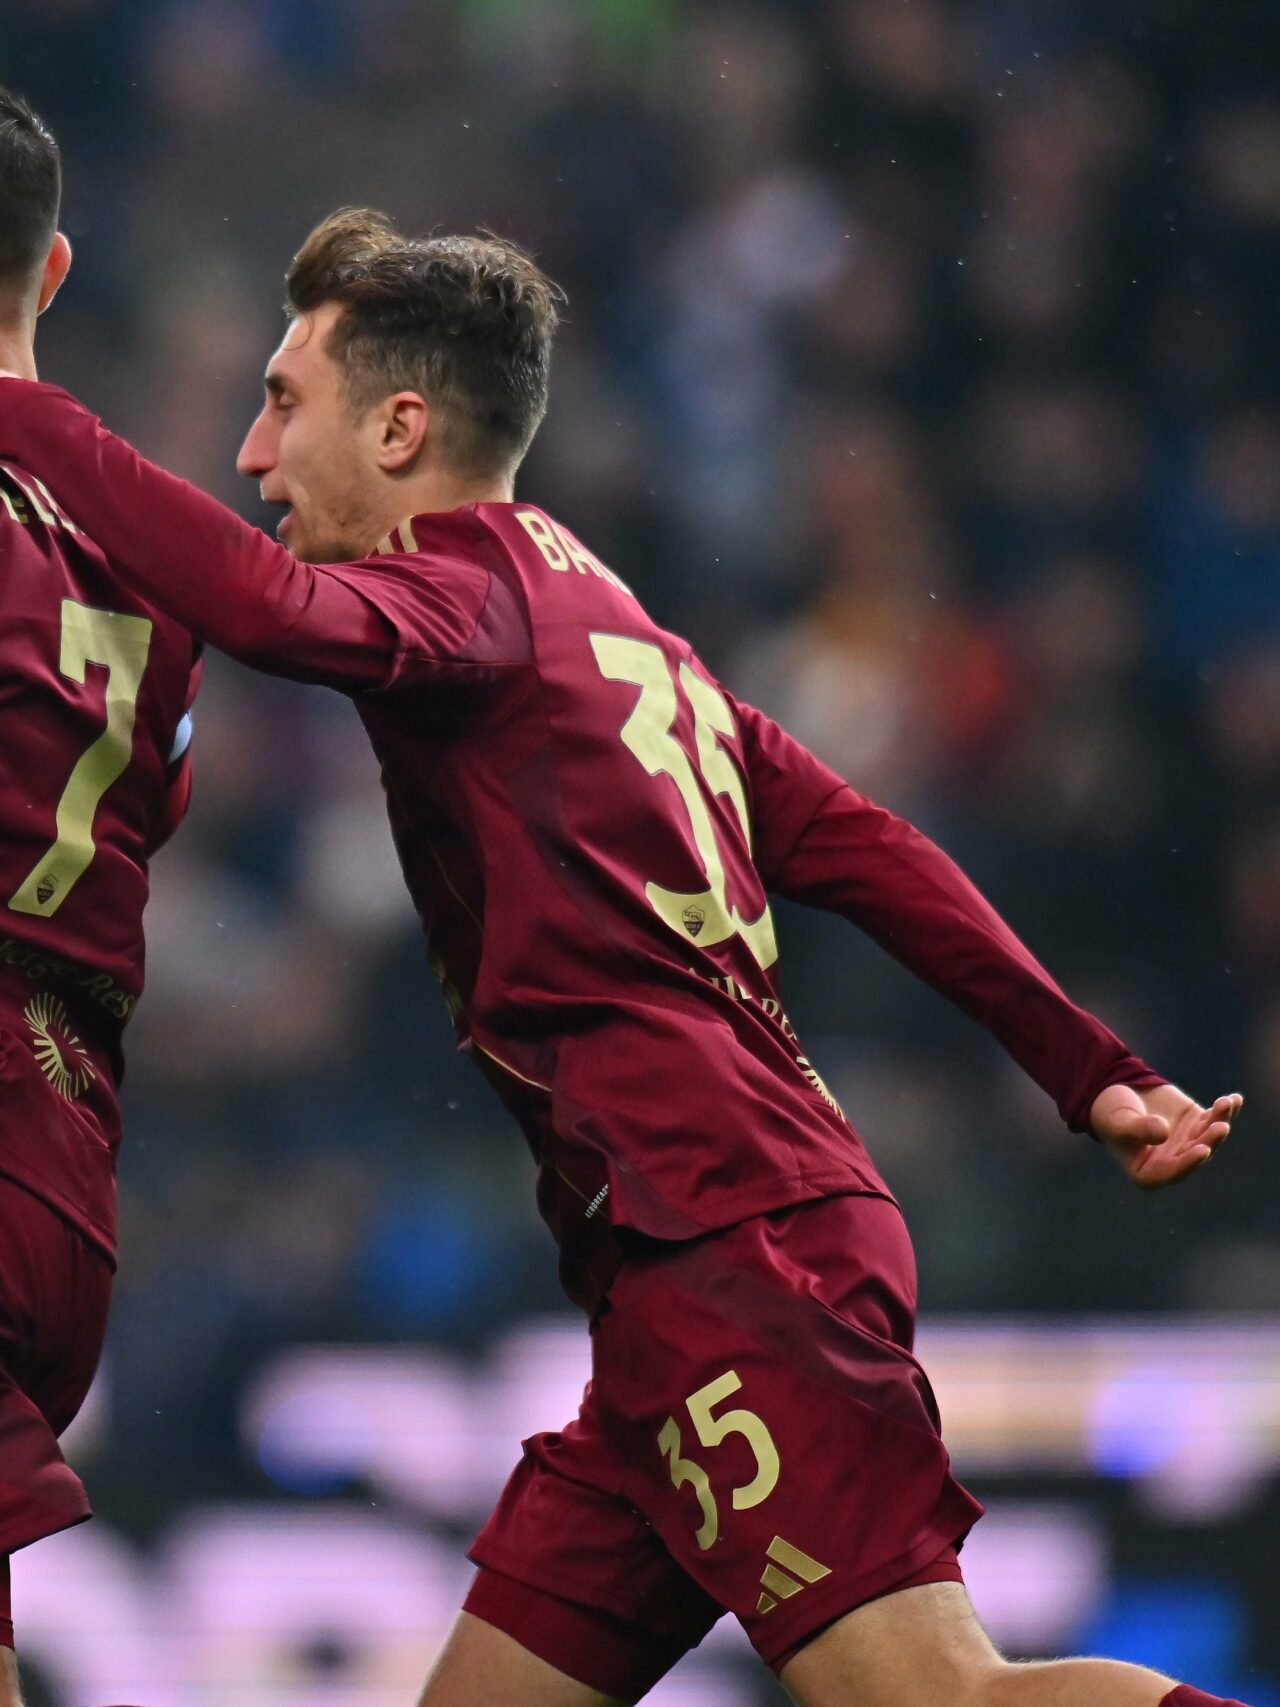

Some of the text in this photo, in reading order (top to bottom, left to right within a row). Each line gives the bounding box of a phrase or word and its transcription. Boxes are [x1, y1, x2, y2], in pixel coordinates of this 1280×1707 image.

[8, 598, 153, 918] 7
[589, 632, 778, 973] 35
[657, 1369, 780, 1551] 35
